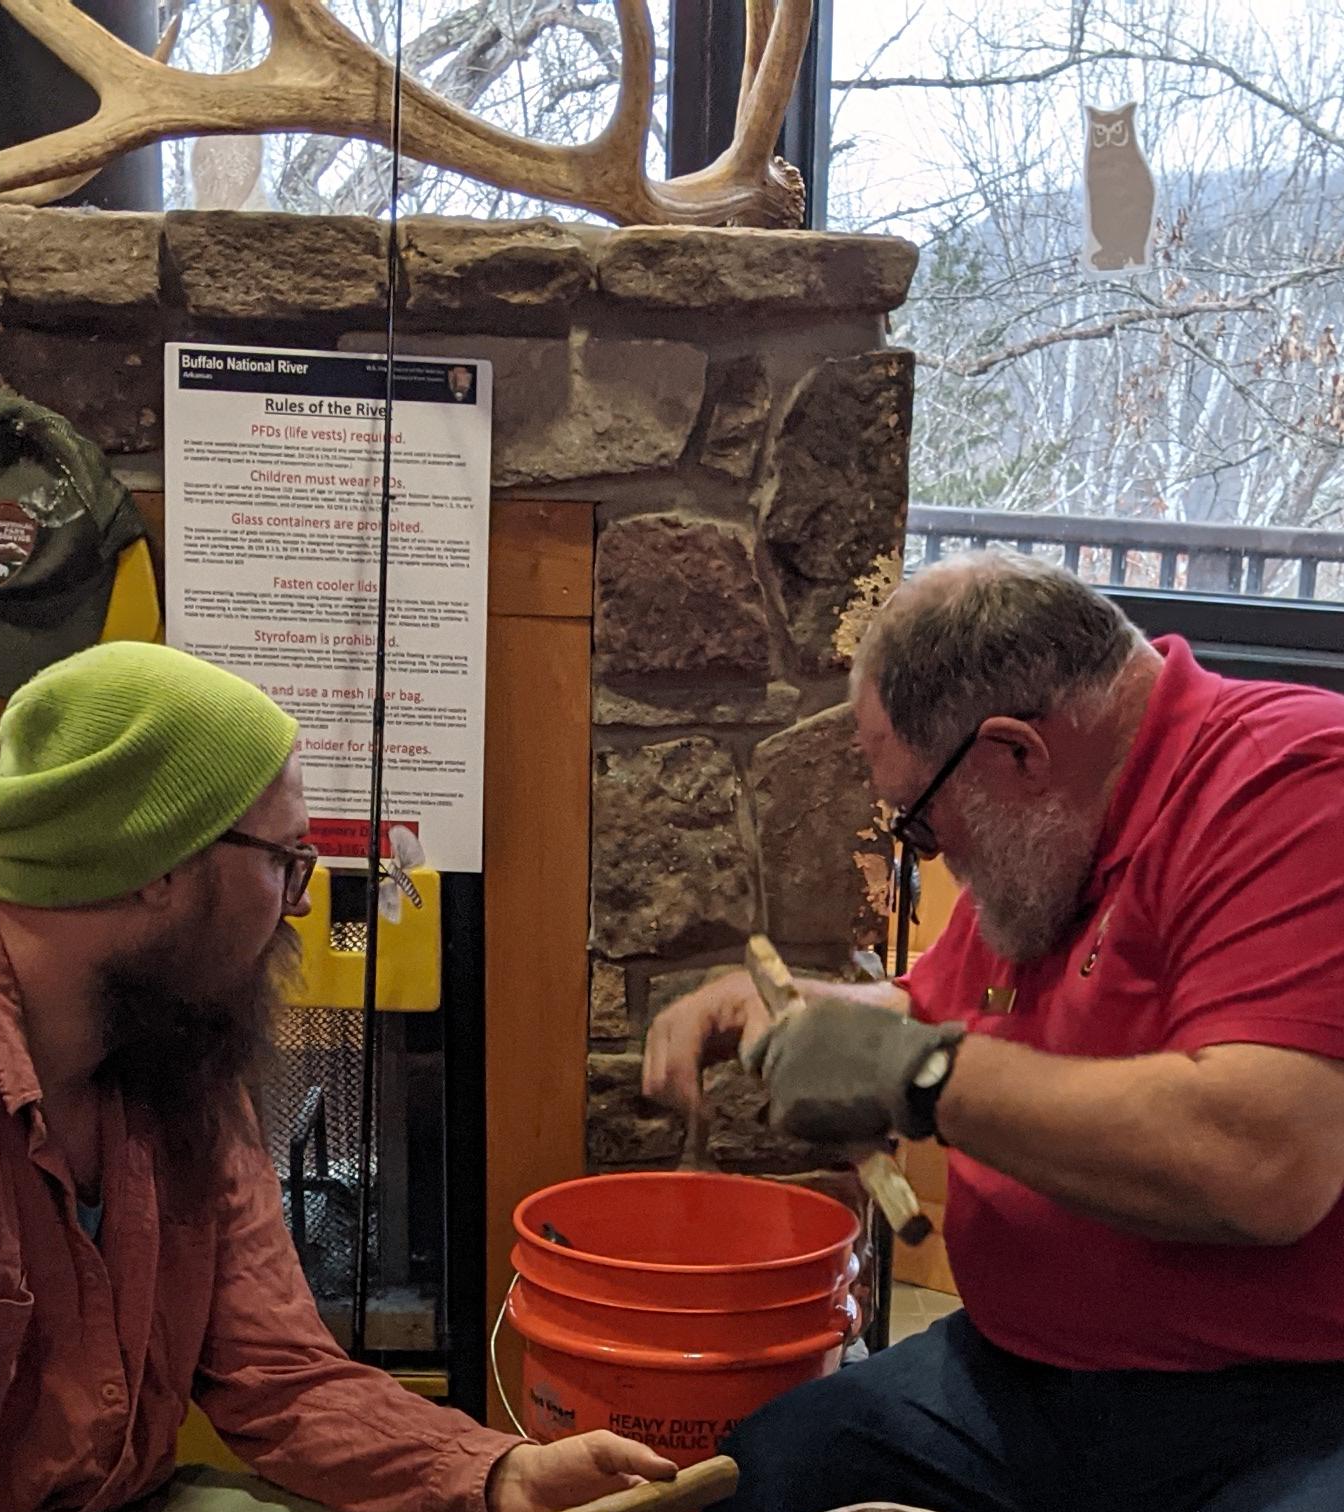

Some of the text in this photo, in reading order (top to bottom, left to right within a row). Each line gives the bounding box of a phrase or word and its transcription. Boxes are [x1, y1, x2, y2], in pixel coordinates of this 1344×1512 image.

[181, 354, 309, 374] Buffalo National River
[265, 398, 393, 418] Rules of the Rive
[251, 424, 406, 445] PFDs (life vests) requid.
[250, 470, 406, 489] Children must wear PDs.
[231, 512, 424, 534] Glass containers are probited.
[273, 576, 313, 590] Fasten
[316, 579, 354, 592] cooler
[255, 630, 399, 648] Styrofoam is prohibid.
[271, 685, 294, 696] and
[297, 688, 318, 698] use
[321, 689, 328, 698] a
[332, 688, 364, 700] mesh
[367, 688, 396, 701] lier
[399, 689, 425, 704] bag.
[305, 738, 345, 752] holder
[348, 739, 365, 752] for
[367, 740, 432, 757] bverages.
[608, 1412, 665, 1431] HEAVY
[669, 1419, 720, 1435] DUTY
